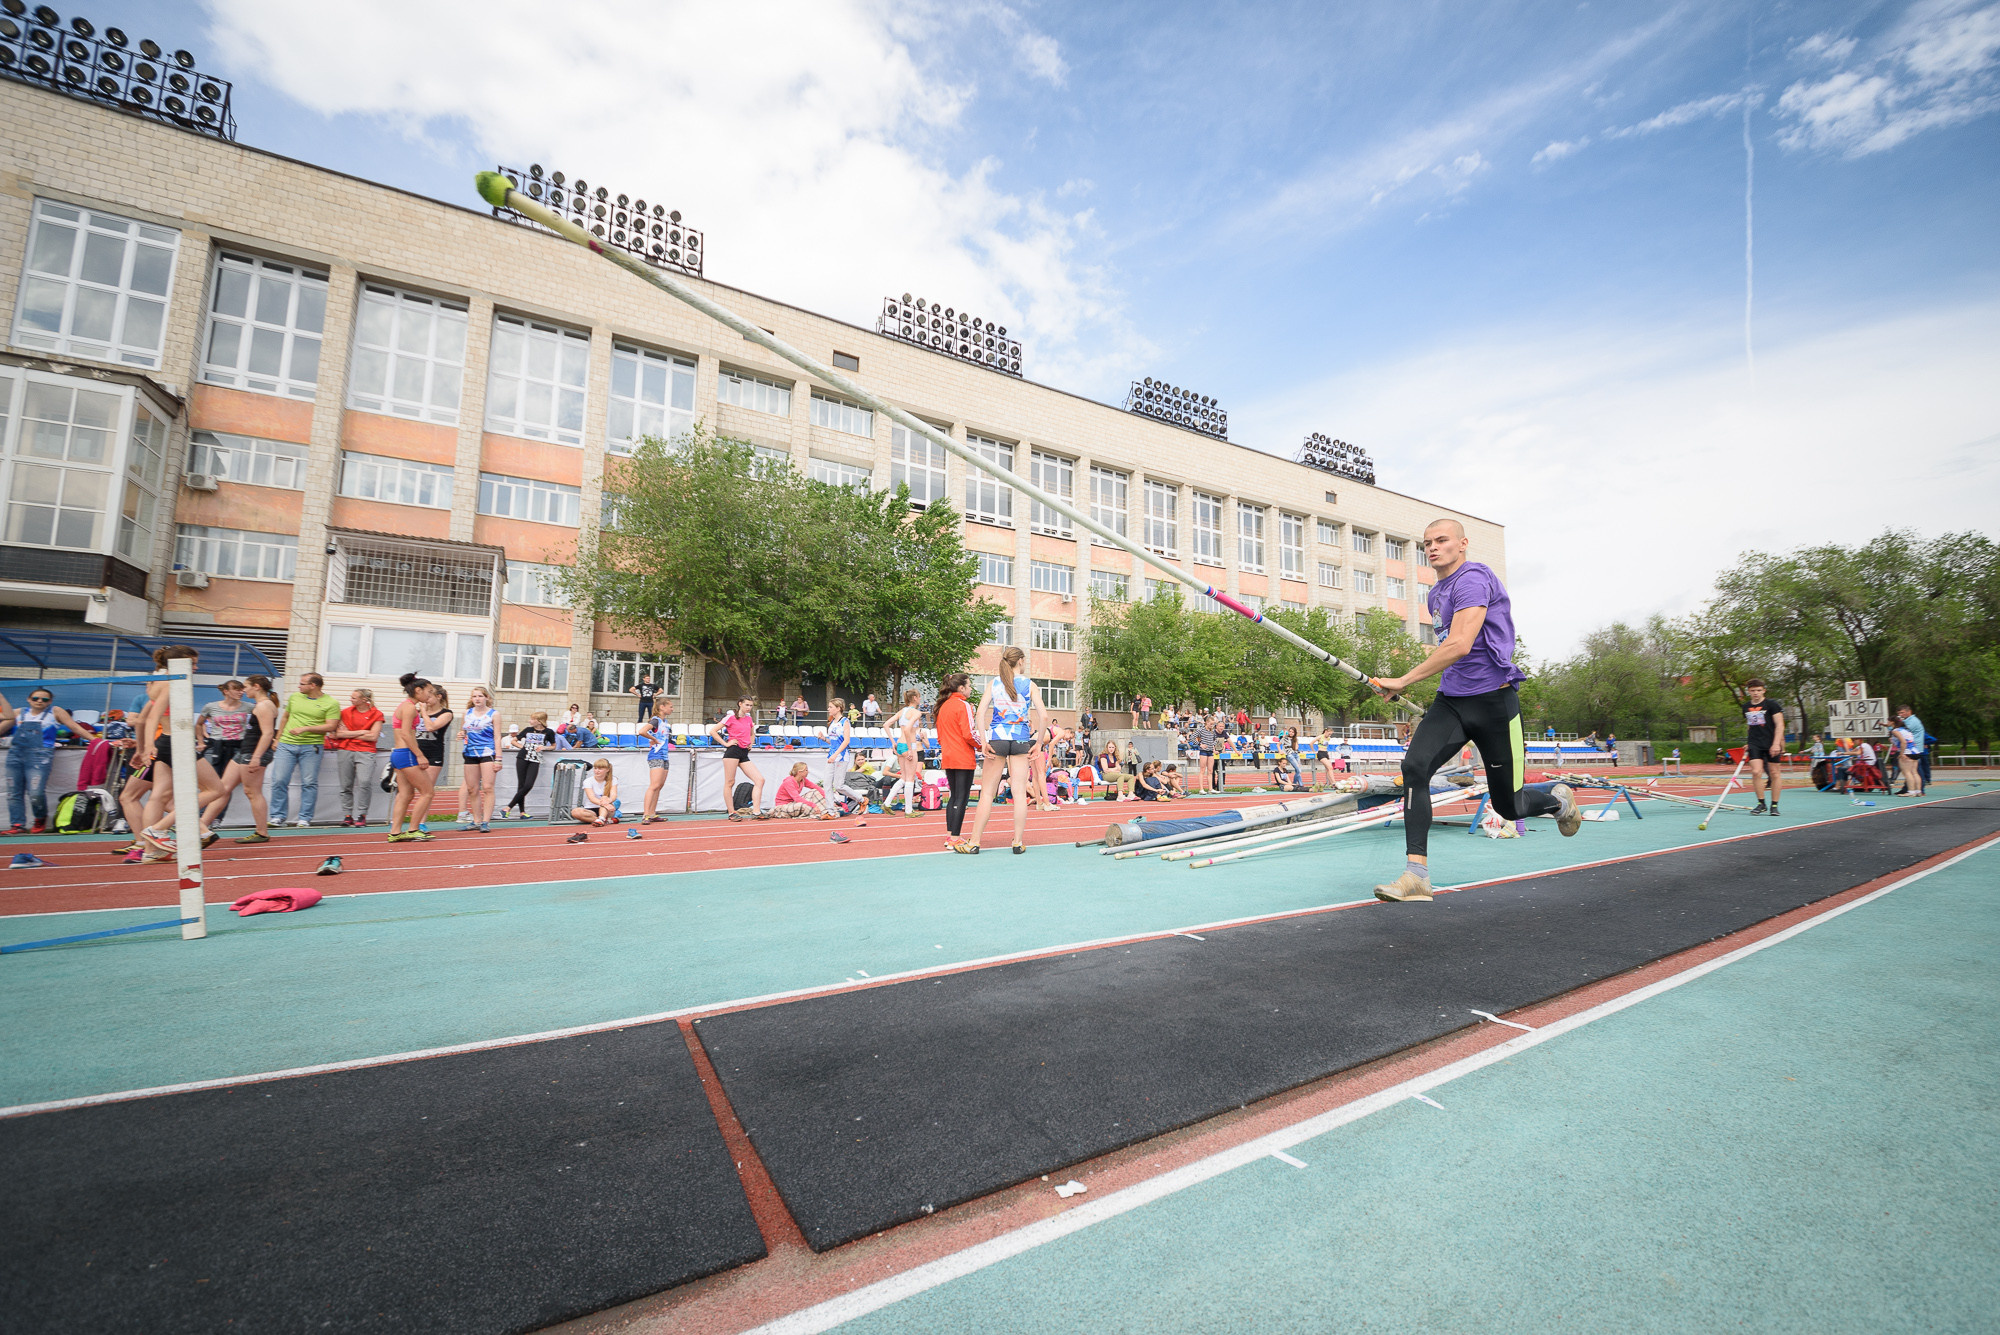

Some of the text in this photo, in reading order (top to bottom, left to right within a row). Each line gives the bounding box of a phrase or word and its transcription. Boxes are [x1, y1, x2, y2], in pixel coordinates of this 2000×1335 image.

[1849, 683, 1860, 696] 3
[1845, 700, 1880, 715] 187
[1845, 718, 1882, 732] 414
